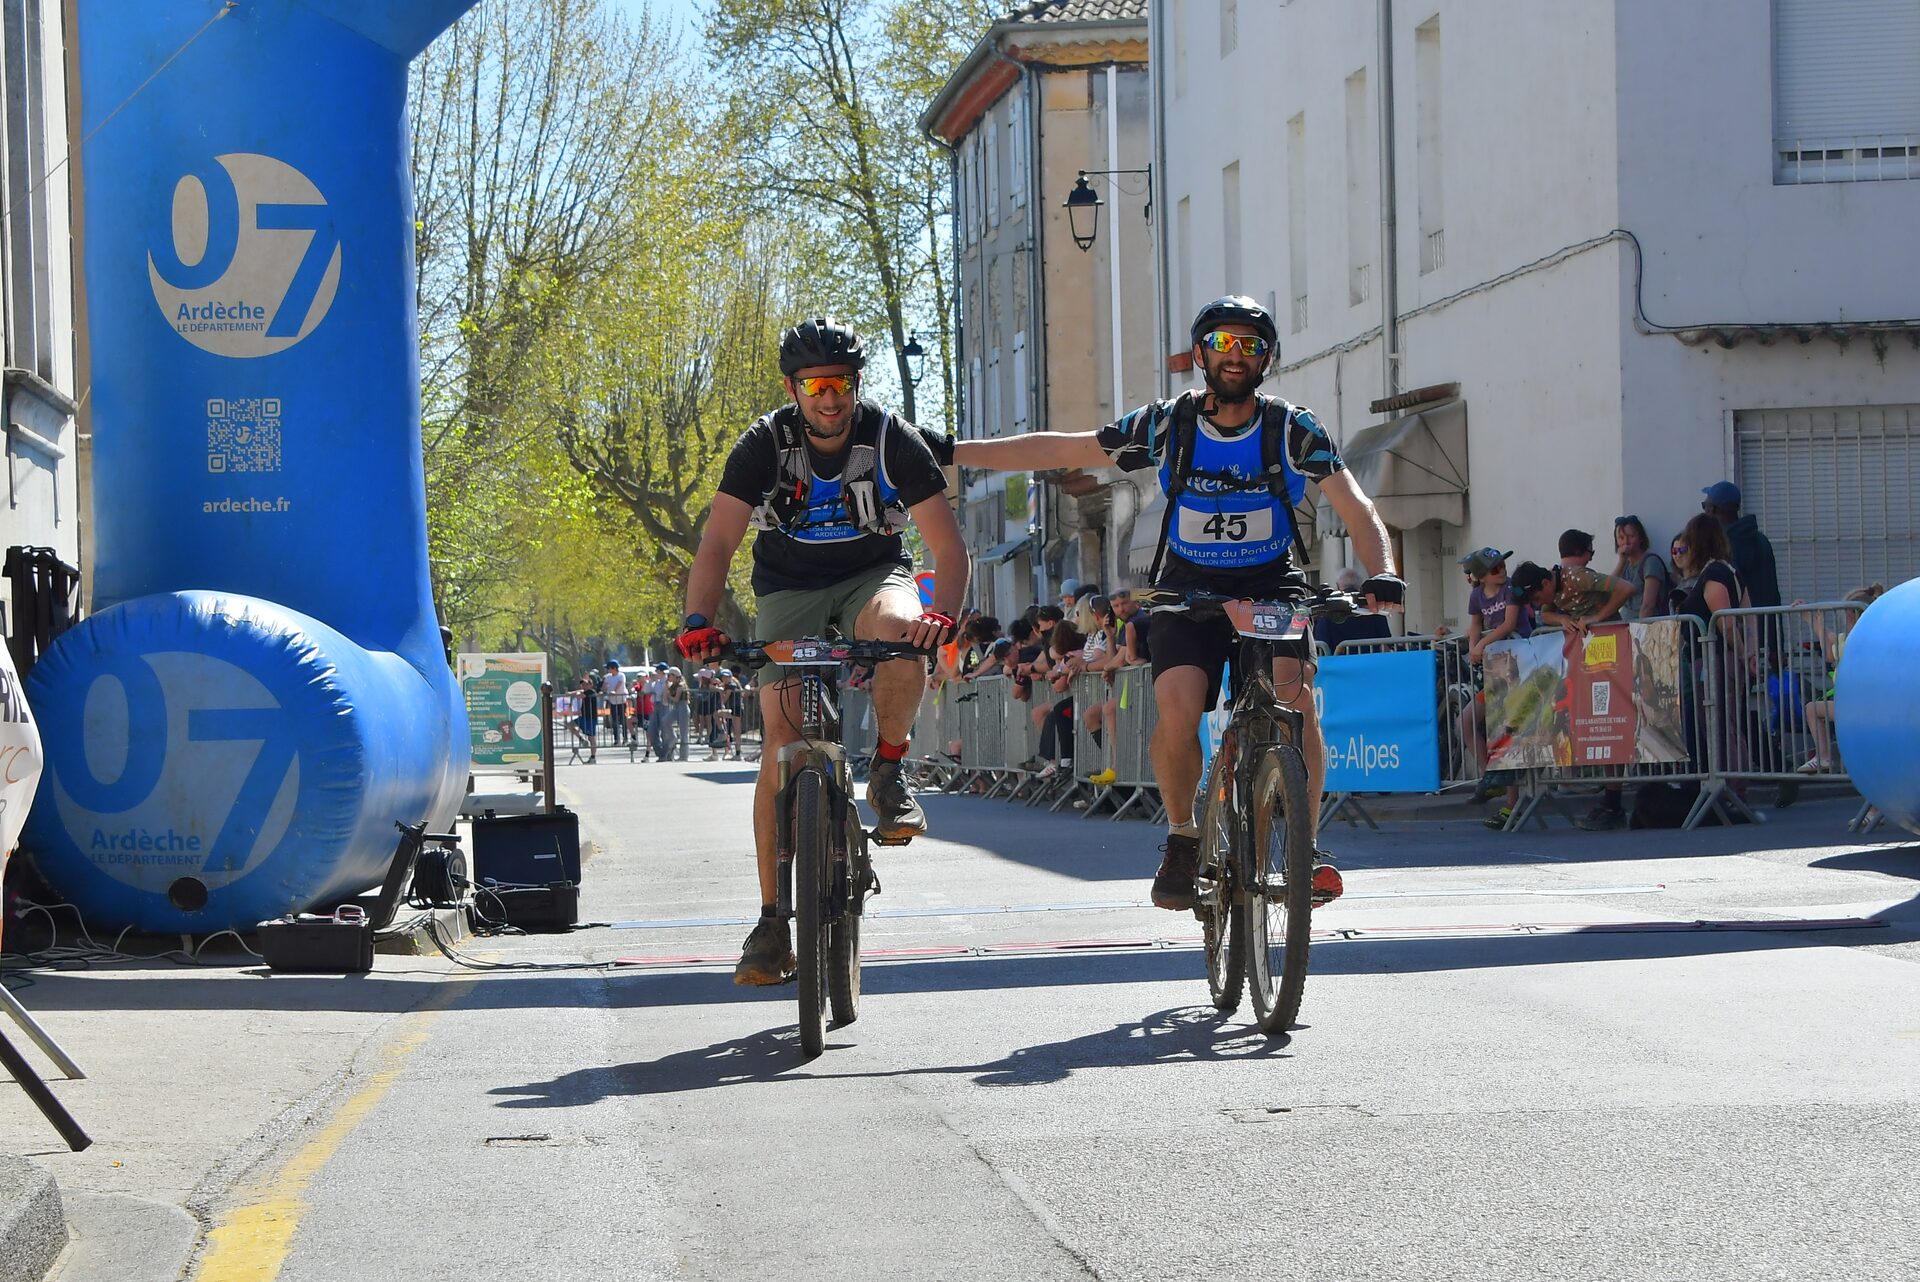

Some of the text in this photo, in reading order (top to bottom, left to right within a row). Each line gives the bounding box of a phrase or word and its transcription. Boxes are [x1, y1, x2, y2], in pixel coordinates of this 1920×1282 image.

[145, 153, 341, 338] 07
[177, 301, 265, 321] Ardèche
[177, 322, 265, 333] LE DÉPARTEMENT
[203, 496, 291, 512] ardeche.fr
[1203, 514, 1248, 541] 45
[1180, 545, 1218, 558] Nature
[1221, 549, 1237, 558] du
[1241, 545, 1267, 556] Pont
[1252, 614, 1277, 629] 45
[792, 647, 817, 659] 45
[52, 651, 300, 873] 07
[1240, 805, 1248, 832] XC
[91, 829, 201, 851] Ardèche
[91, 853, 201, 866] LE DÉPARTEMENT
